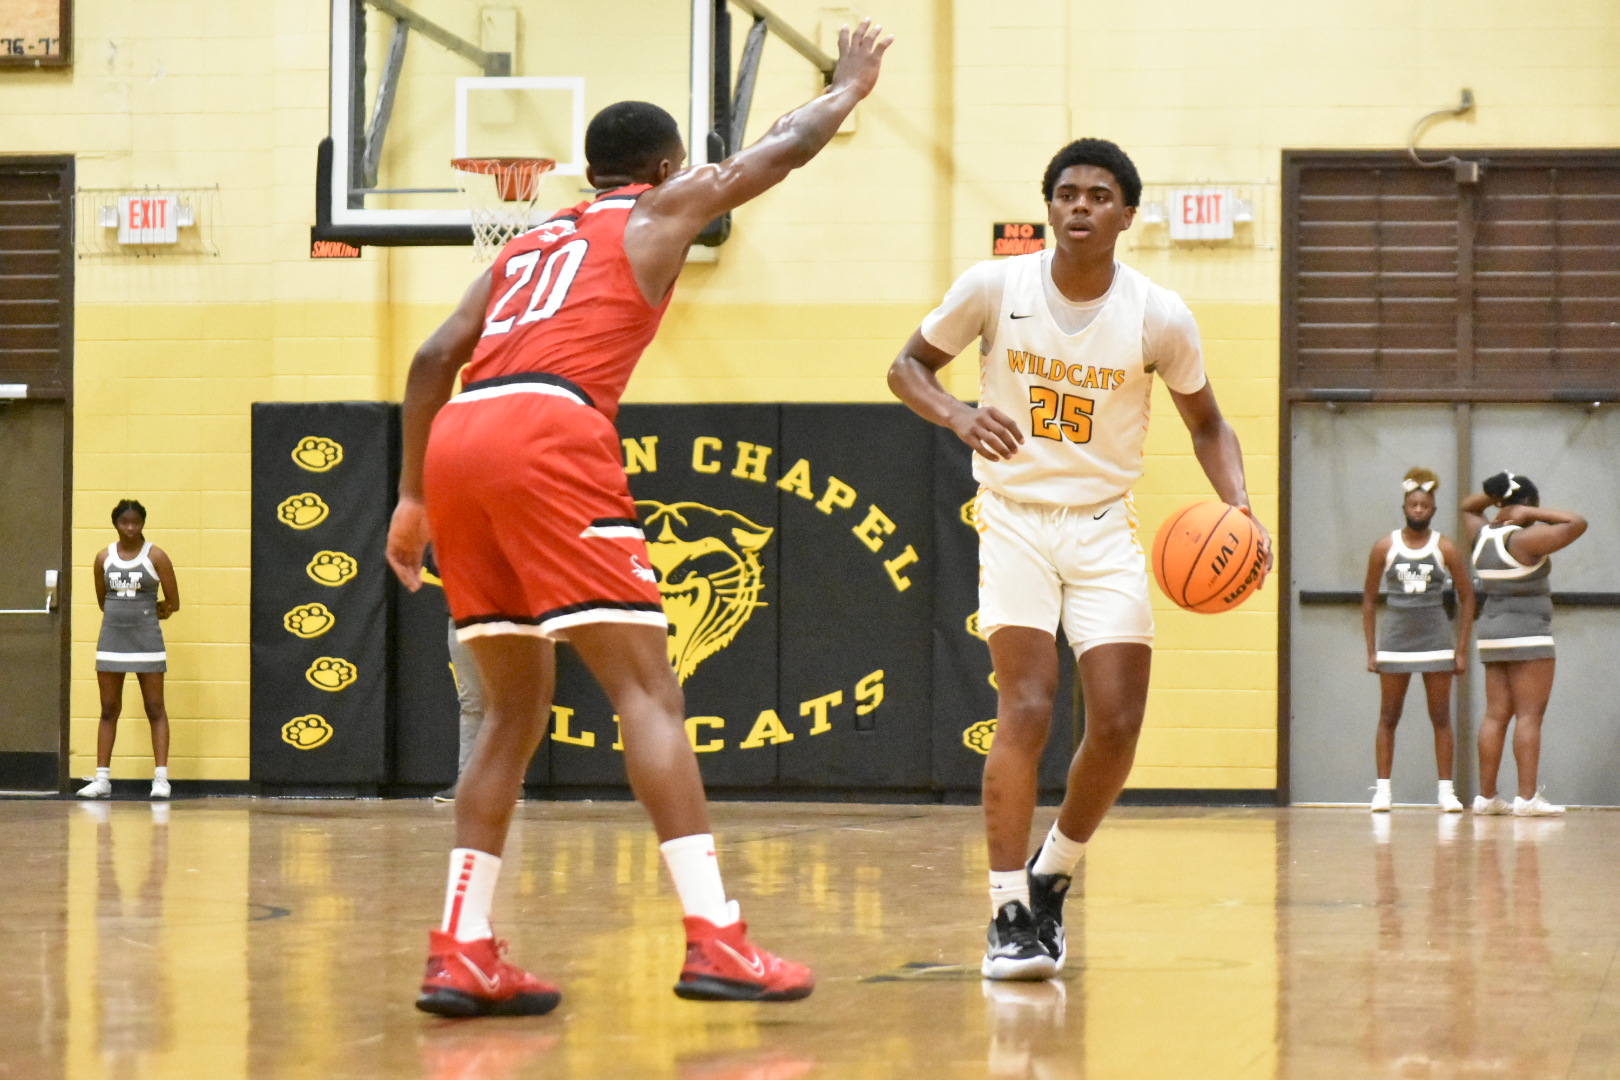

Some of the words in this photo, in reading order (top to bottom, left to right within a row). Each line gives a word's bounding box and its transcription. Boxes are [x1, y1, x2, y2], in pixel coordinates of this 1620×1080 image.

[129, 199, 168, 229] EXIT
[1004, 223, 1034, 238] NO
[1183, 193, 1223, 225] EXIT
[480, 238, 590, 339] 20
[1007, 348, 1126, 391] WILDCATS
[1029, 385, 1095, 444] 25
[691, 435, 920, 592] CHAPEL
